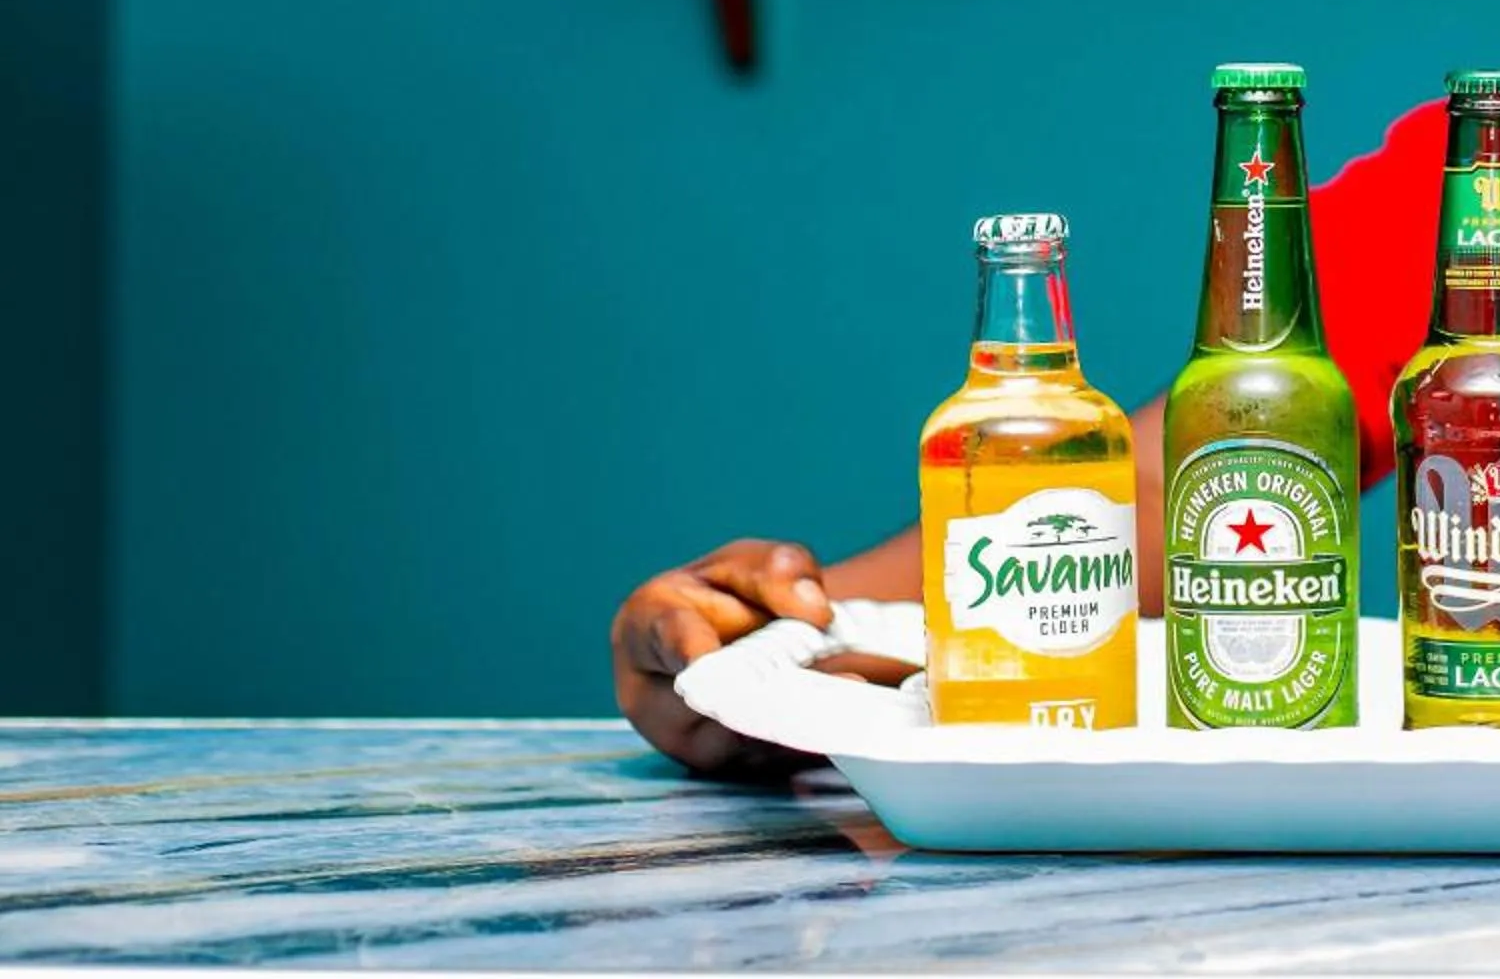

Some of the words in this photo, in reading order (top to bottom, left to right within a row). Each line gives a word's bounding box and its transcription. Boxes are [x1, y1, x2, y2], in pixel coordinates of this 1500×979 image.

[1243, 194, 1264, 311] Heineken
[1180, 471, 1248, 542] HEINEKEN
[1256, 471, 1330, 542] ORIGINAL
[967, 535, 1133, 610] Savanna
[1172, 565, 1342, 607] Heineken
[1029, 602, 1099, 620] PREMIUM
[1039, 620, 1090, 636] CIDER
[1183, 651, 1219, 701] PURE
[1222, 688, 1275, 712] MALT
[1280, 650, 1329, 704] LAGER
